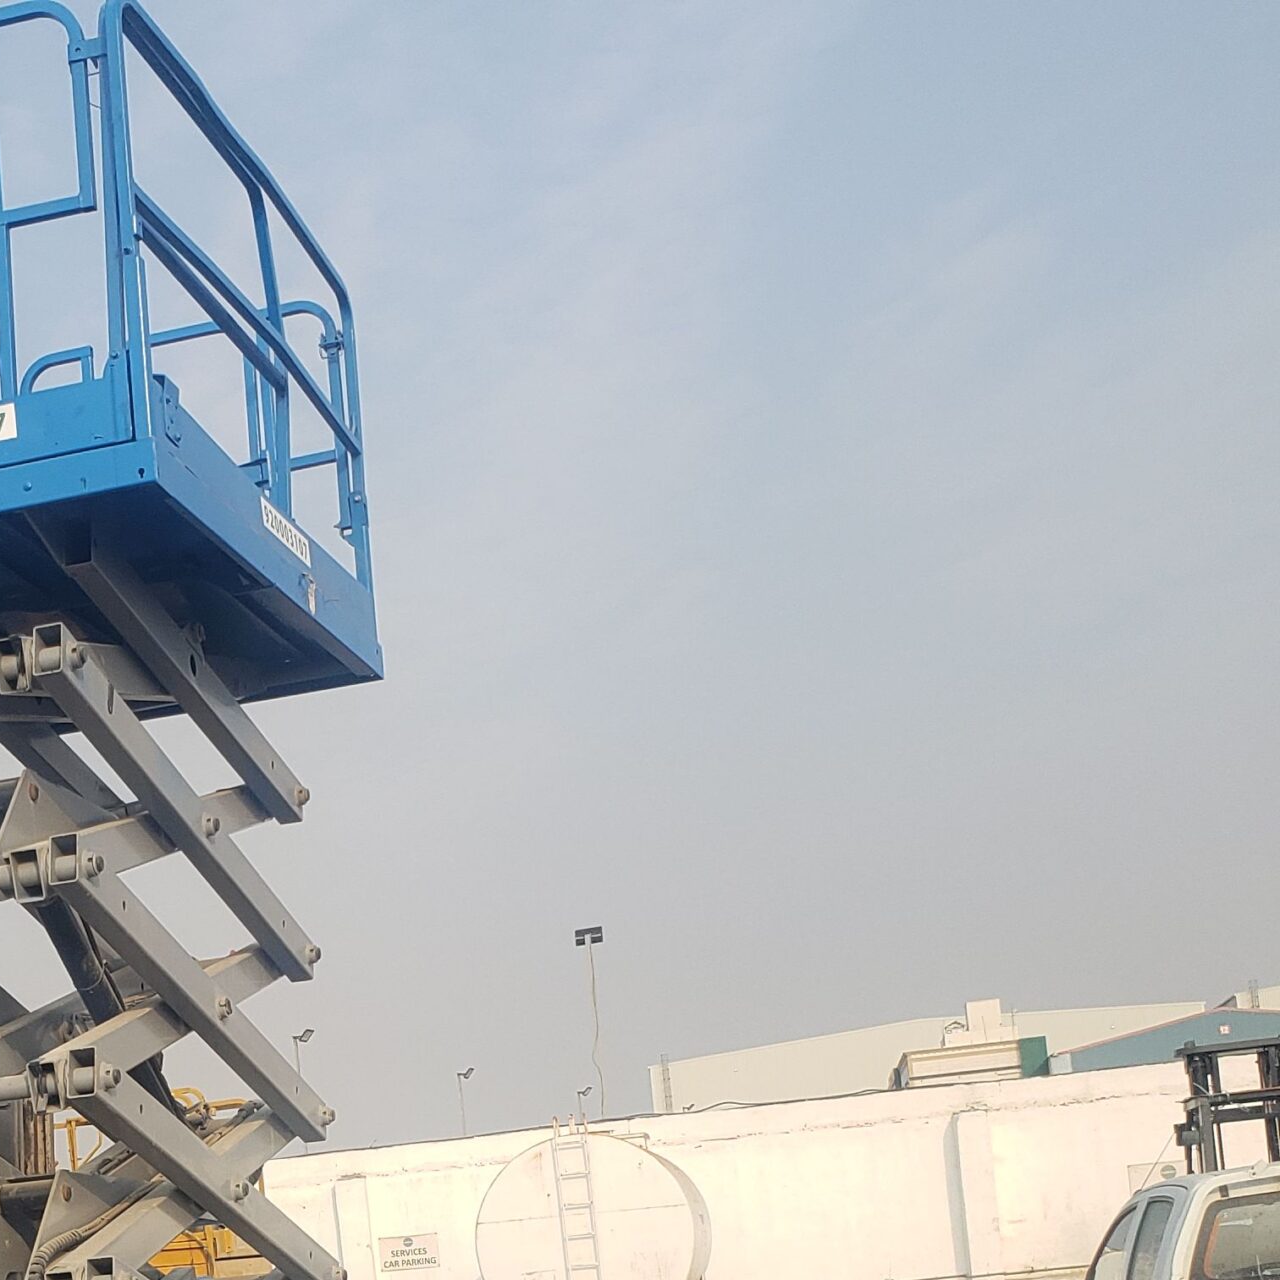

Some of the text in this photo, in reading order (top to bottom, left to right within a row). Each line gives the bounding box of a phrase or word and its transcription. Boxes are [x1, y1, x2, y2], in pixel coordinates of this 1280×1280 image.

[263, 504, 308, 561] 920003107
[390, 1247, 428, 1258] SERVICES
[383, 1256, 438, 1269] CAR PARKING
